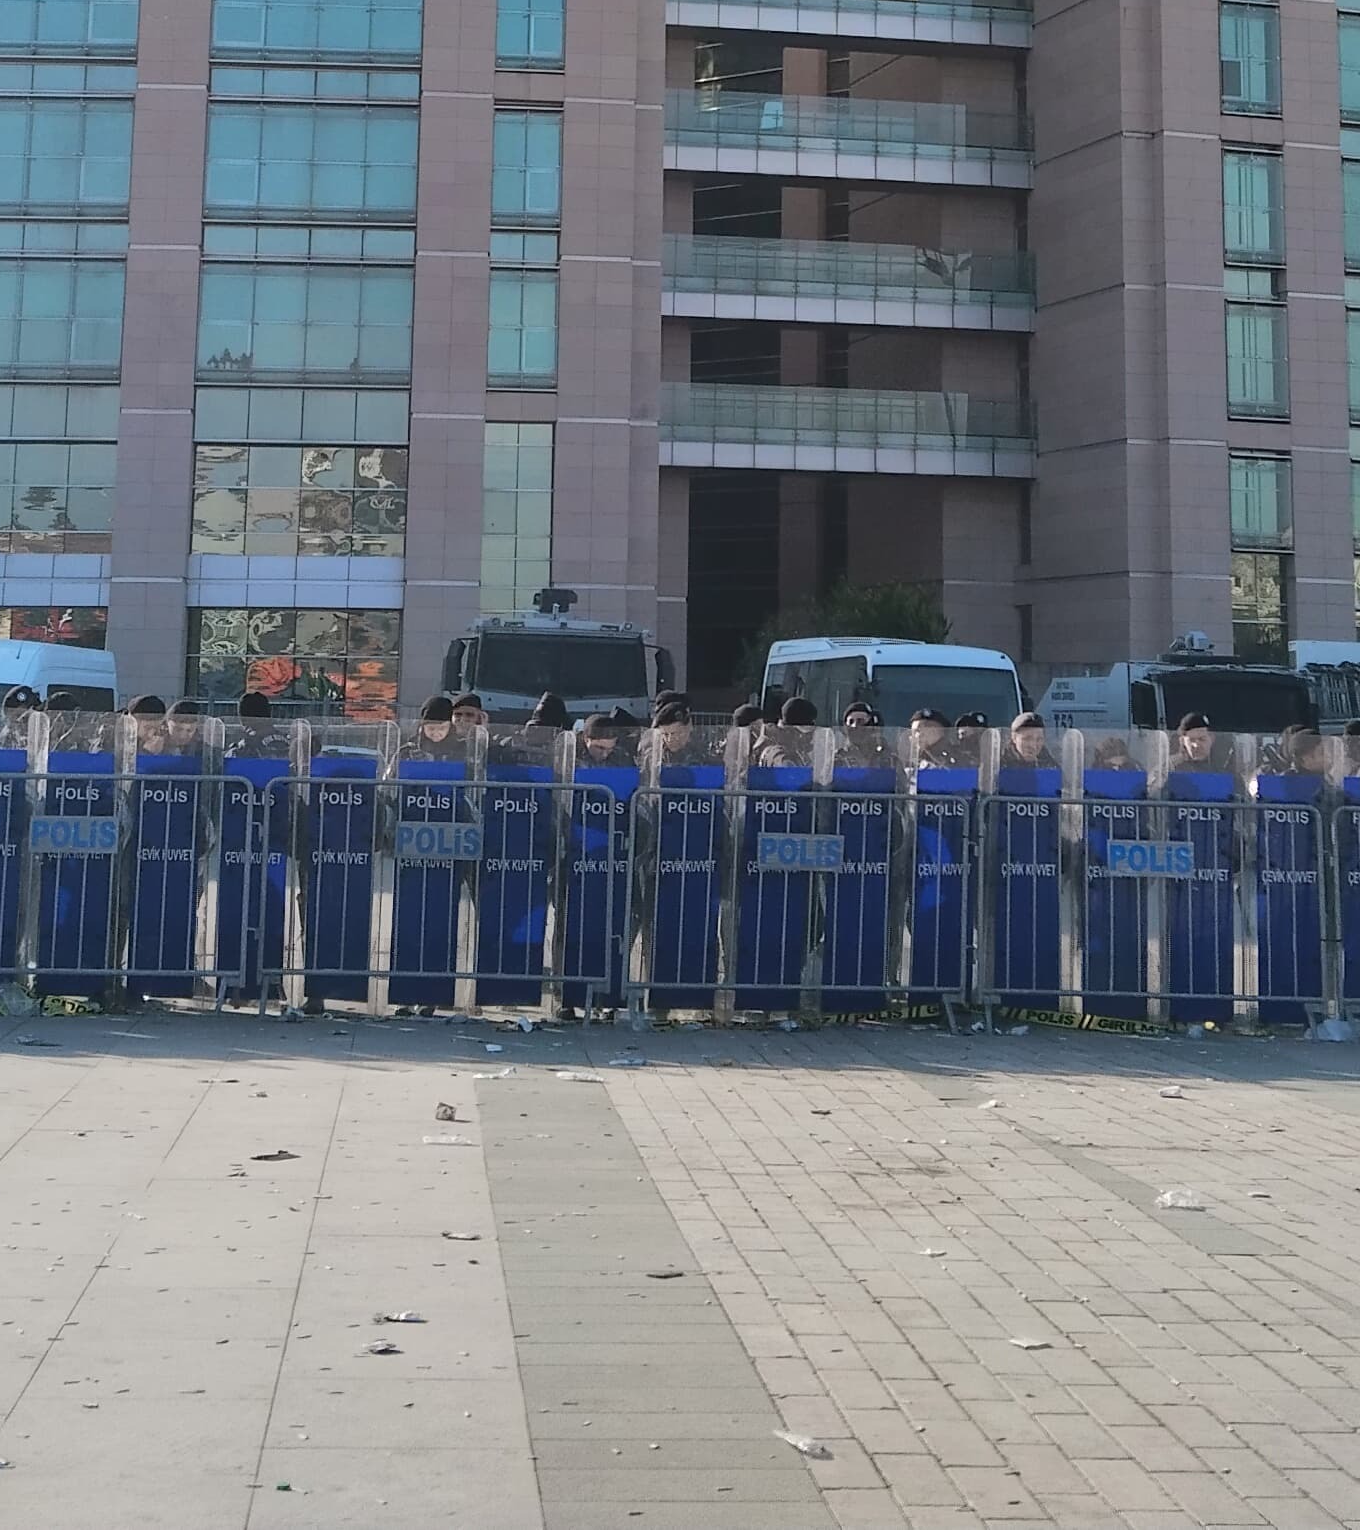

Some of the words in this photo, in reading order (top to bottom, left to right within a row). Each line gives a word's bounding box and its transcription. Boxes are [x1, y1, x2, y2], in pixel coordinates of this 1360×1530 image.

[32, 820, 116, 849] POLİS
[398, 827, 481, 856] POLİS
[225, 849, 248, 865] ÇEVİ
[1110, 844, 1191, 872] POLİS
